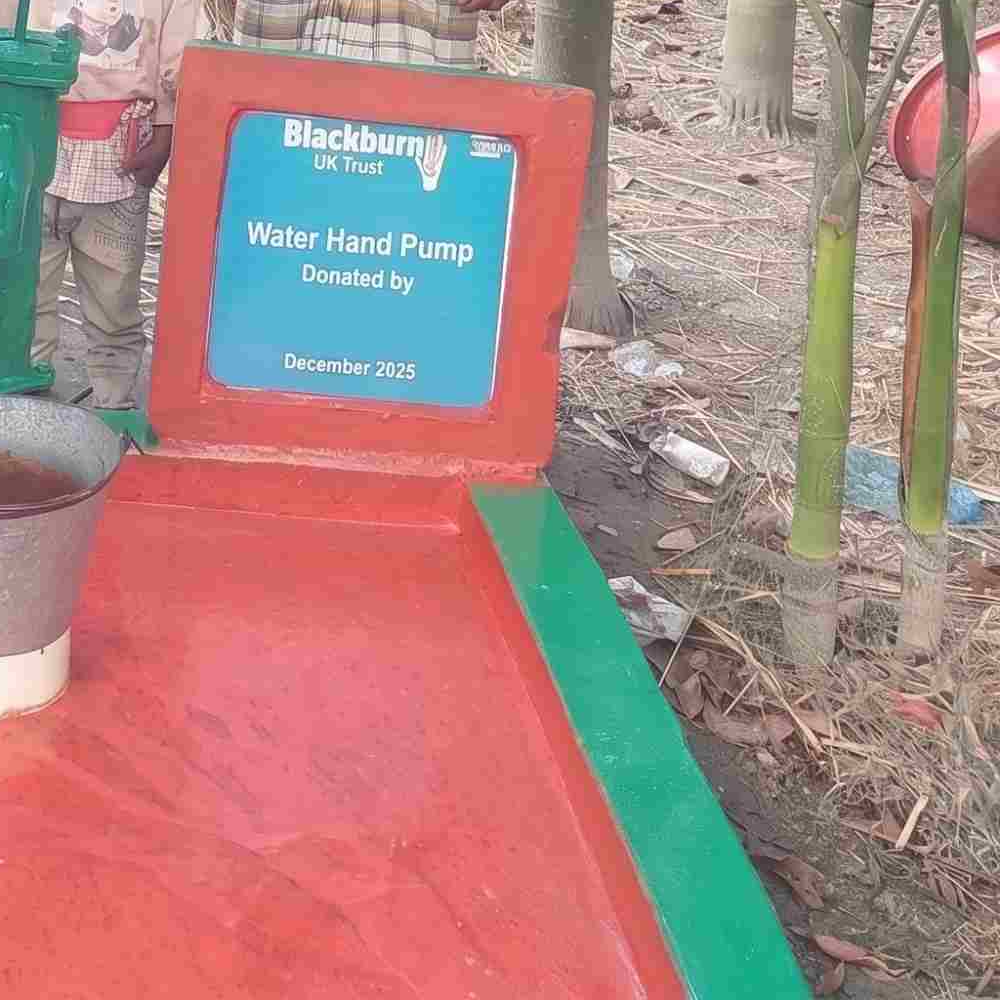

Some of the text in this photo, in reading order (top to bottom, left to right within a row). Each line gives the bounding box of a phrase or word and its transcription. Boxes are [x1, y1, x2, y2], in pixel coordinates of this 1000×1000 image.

[283, 118, 425, 157] Blackburn
[313, 154, 384, 175] UK Trust
[247, 221, 474, 267] Water Hand Pump
[302, 263, 415, 295] Donated by
[284, 353, 416, 380] December 2025
